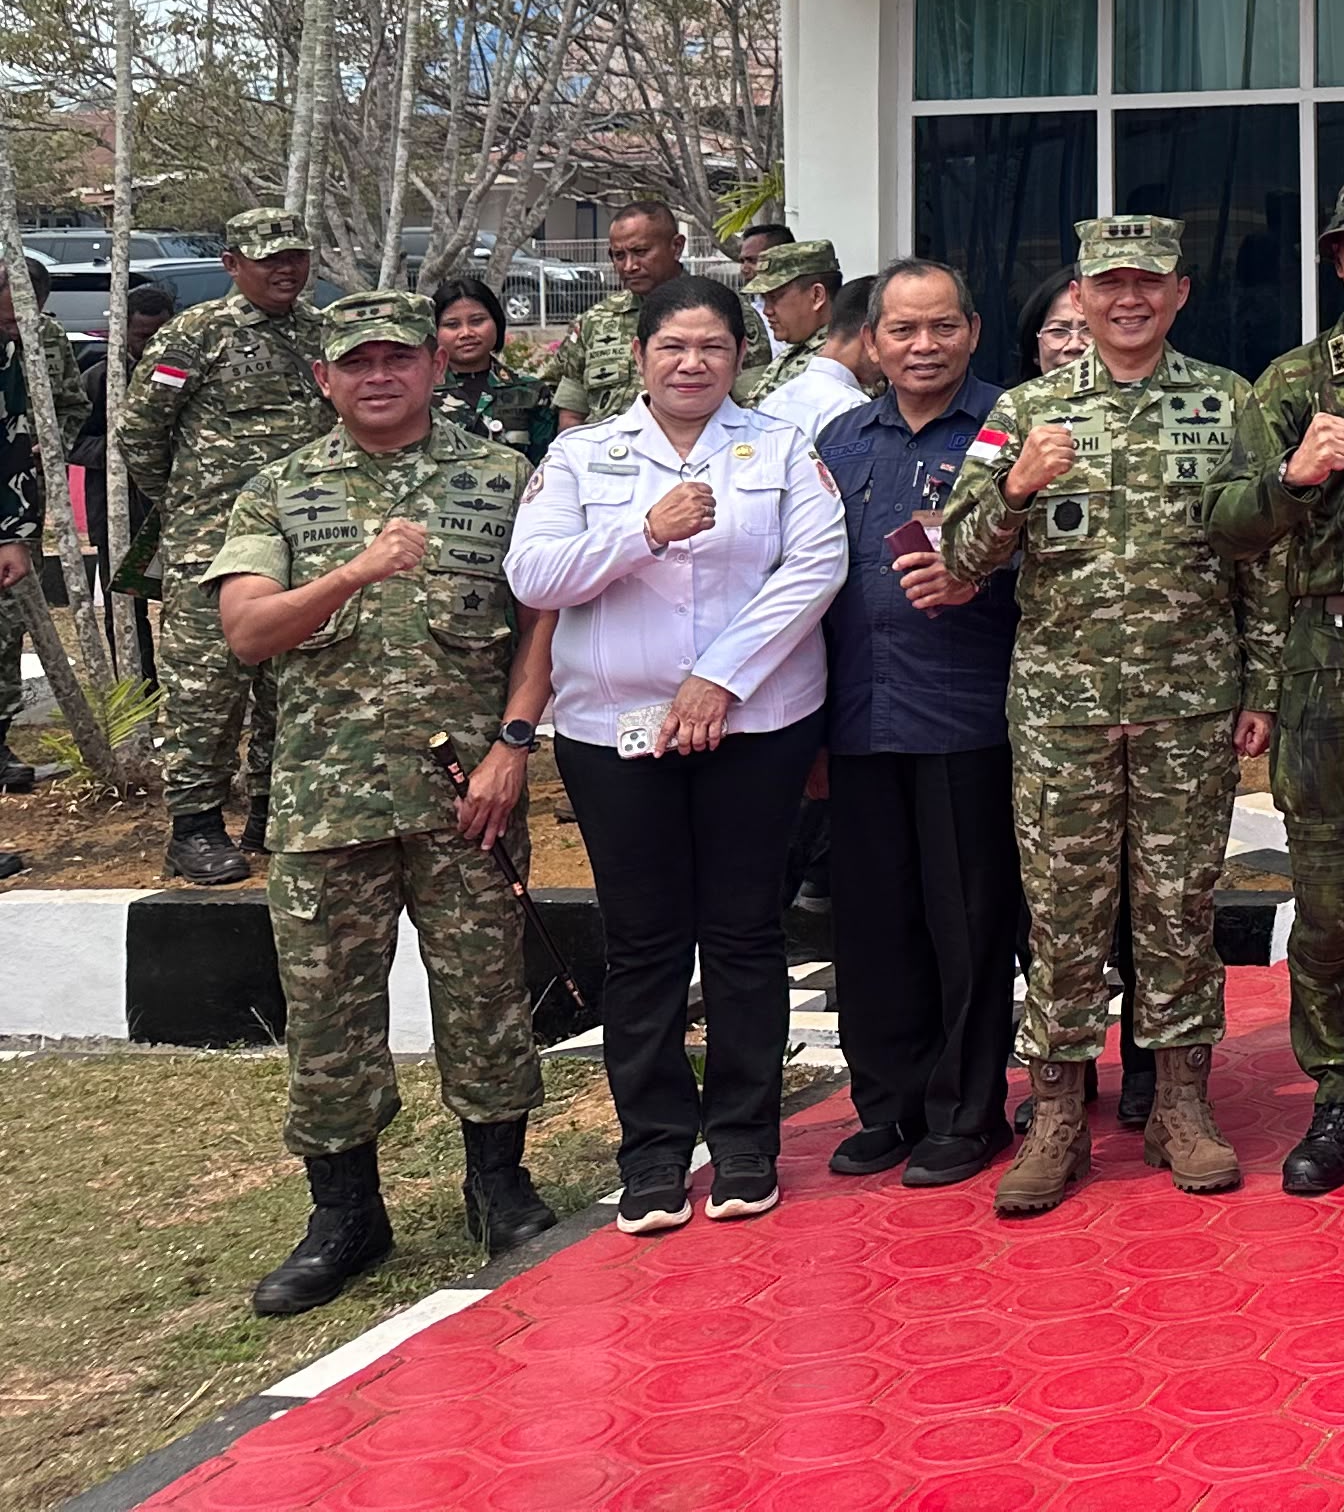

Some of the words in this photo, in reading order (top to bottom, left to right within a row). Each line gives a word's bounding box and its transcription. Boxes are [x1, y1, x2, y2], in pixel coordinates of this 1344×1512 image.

[231, 360, 273, 377] SAGE
[1171, 431, 1201, 446] TNI
[1207, 431, 1230, 445] AL
[303, 525, 358, 543] PRABOWO
[438, 516, 473, 532] TNI
[480, 522, 506, 538] AD
